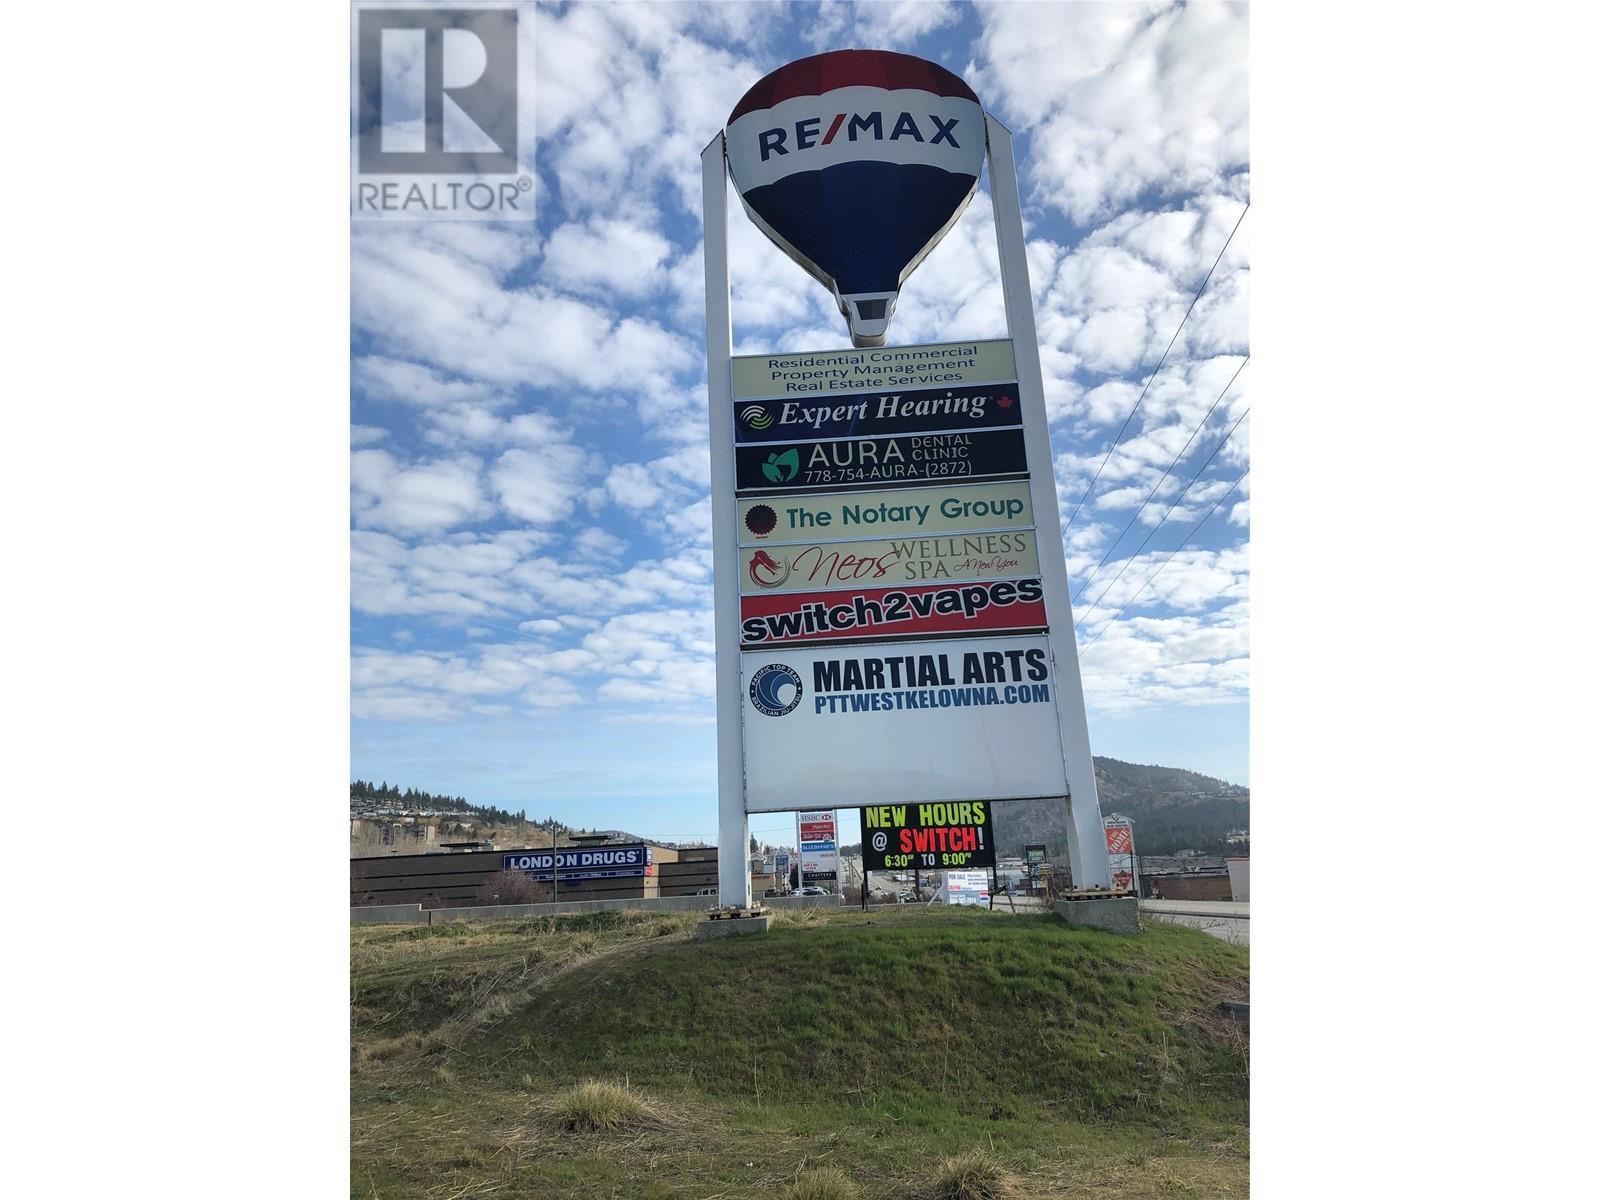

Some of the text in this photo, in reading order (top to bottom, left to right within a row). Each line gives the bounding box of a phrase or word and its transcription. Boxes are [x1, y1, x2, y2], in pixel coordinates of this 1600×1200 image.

[758, 111, 961, 162] RE/MAX
[768, 345, 978, 369] Residential Commercial
[771, 357, 976, 382] Property Management
[786, 371, 963, 392] Real Estate Services
[777, 391, 988, 429] Expert Hearing
[808, 439, 905, 468] AURA
[911, 434, 973, 448] DENTAL
[911, 446, 969, 460] CLINIC
[804, 459, 972, 483] 778-754-AURA-(2872)
[786, 498, 1024, 529] The Notary Group
[890, 533, 1026, 560] WELLNESS
[905, 560, 951, 580] SPA
[741, 579, 1044, 643] switch2vapes
[751, 665, 771, 686] PACIFIC
[786, 667, 801, 683] TEAM
[813, 648, 1048, 693] MARTIAL ARTS
[815, 683, 1050, 714] PTTWESTKELOWNA.COM
[865, 801, 986, 828] NEW HOURS
[872, 827, 985, 853] @ SWITCH!
[510, 853, 577, 869] LONDON
[582, 850, 637, 866] DRUGS
[921, 854, 936, 866] TO
